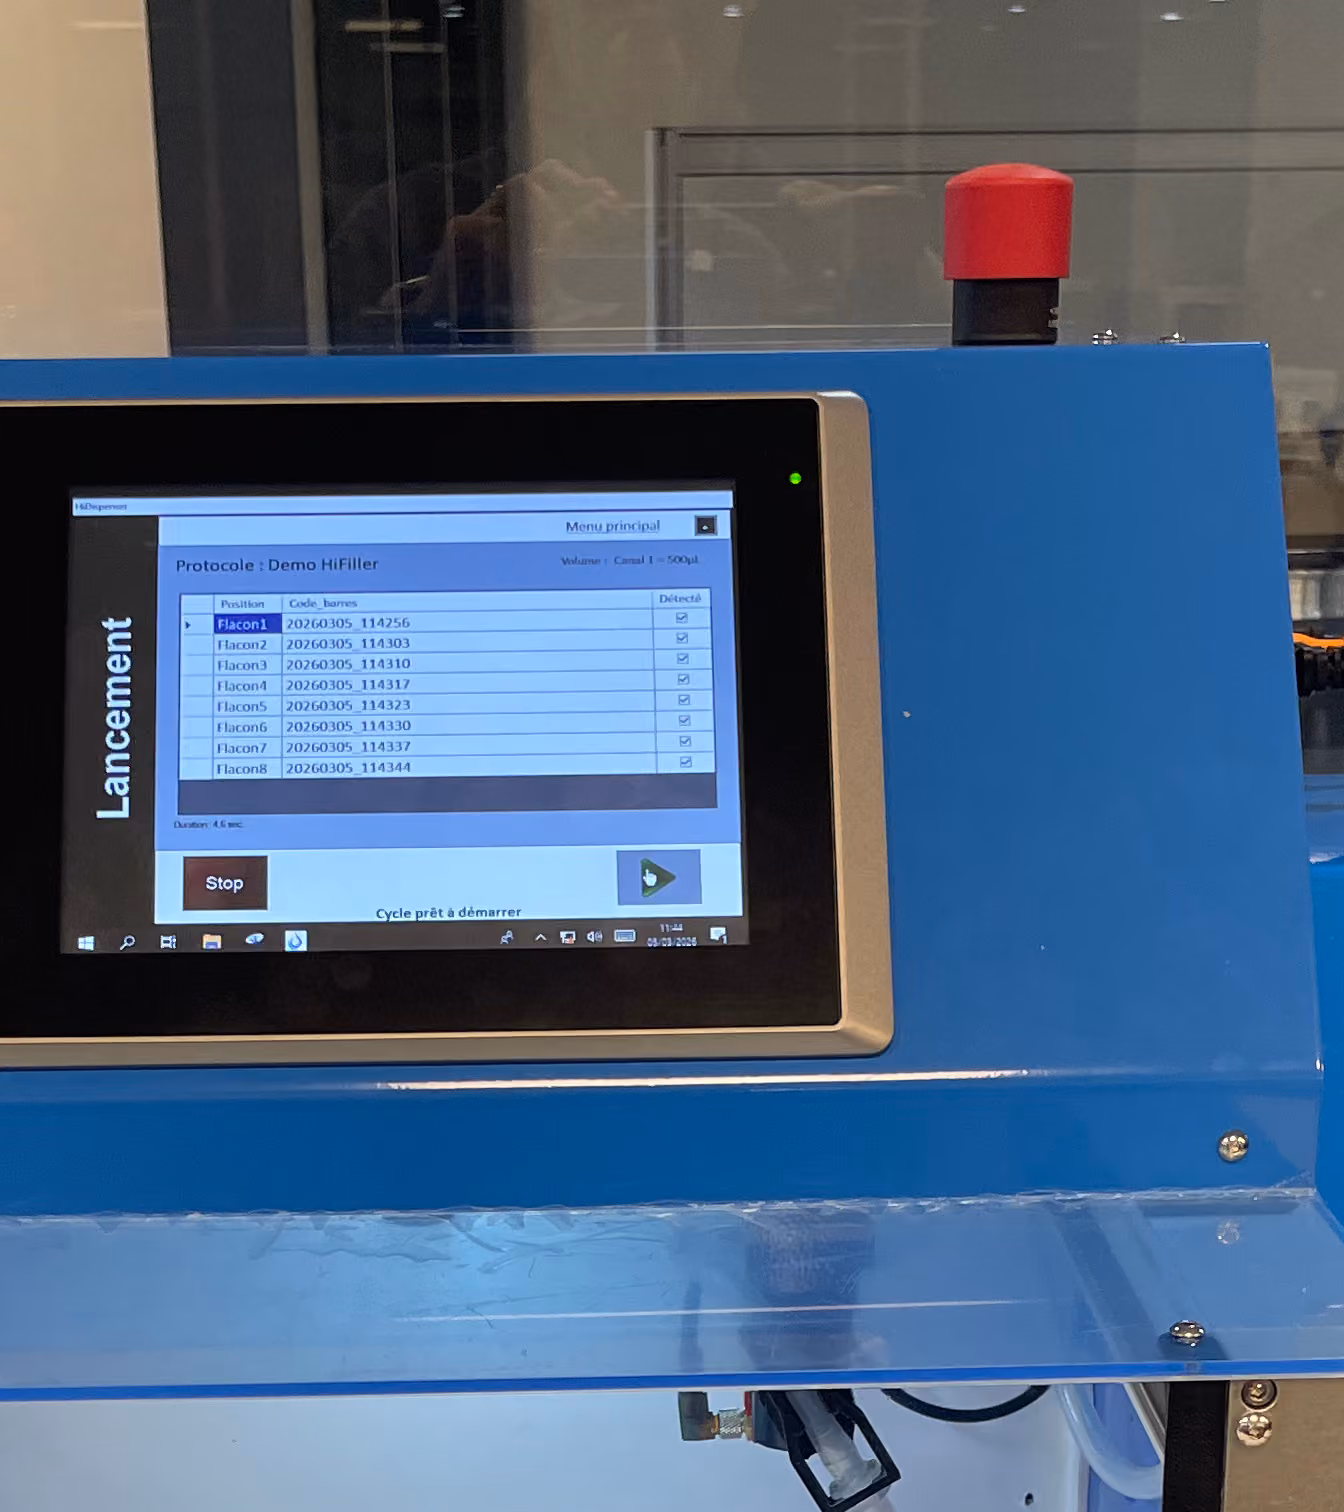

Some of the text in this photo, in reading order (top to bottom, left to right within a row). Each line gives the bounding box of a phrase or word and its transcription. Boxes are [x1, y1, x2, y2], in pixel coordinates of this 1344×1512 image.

[566, 520, 660, 534] Menu principal
[176, 558, 254, 573] Protocole
[268, 558, 317, 572] Demo
[321, 557, 379, 572] HiFiller
[561, 556, 601, 566] Volume
[614, 555, 645, 566] Canal
[220, 593, 702, 611] Position Code_barres Détecté
[217, 617, 411, 631] Flacon1 20260305_114256
[217, 638, 411, 652] Flacon2 20260305_114303
[217, 658, 411, 672] Flacon3 20260305_114310
[217, 679, 411, 693] Flacon4 20260305_114317
[217, 700, 411, 713] Flacon5 20260305_114323
[96, 616, 132, 819] Lancement
[217, 720, 411, 734] Flacon6 20260305_114330
[217, 741, 411, 755] Flacon7 20260305_114337
[217, 762, 411, 776] Flacon8 20260305_114344
[206, 875, 244, 893] Stop
[376, 905, 522, 922] Cycle prêt à démarrer
